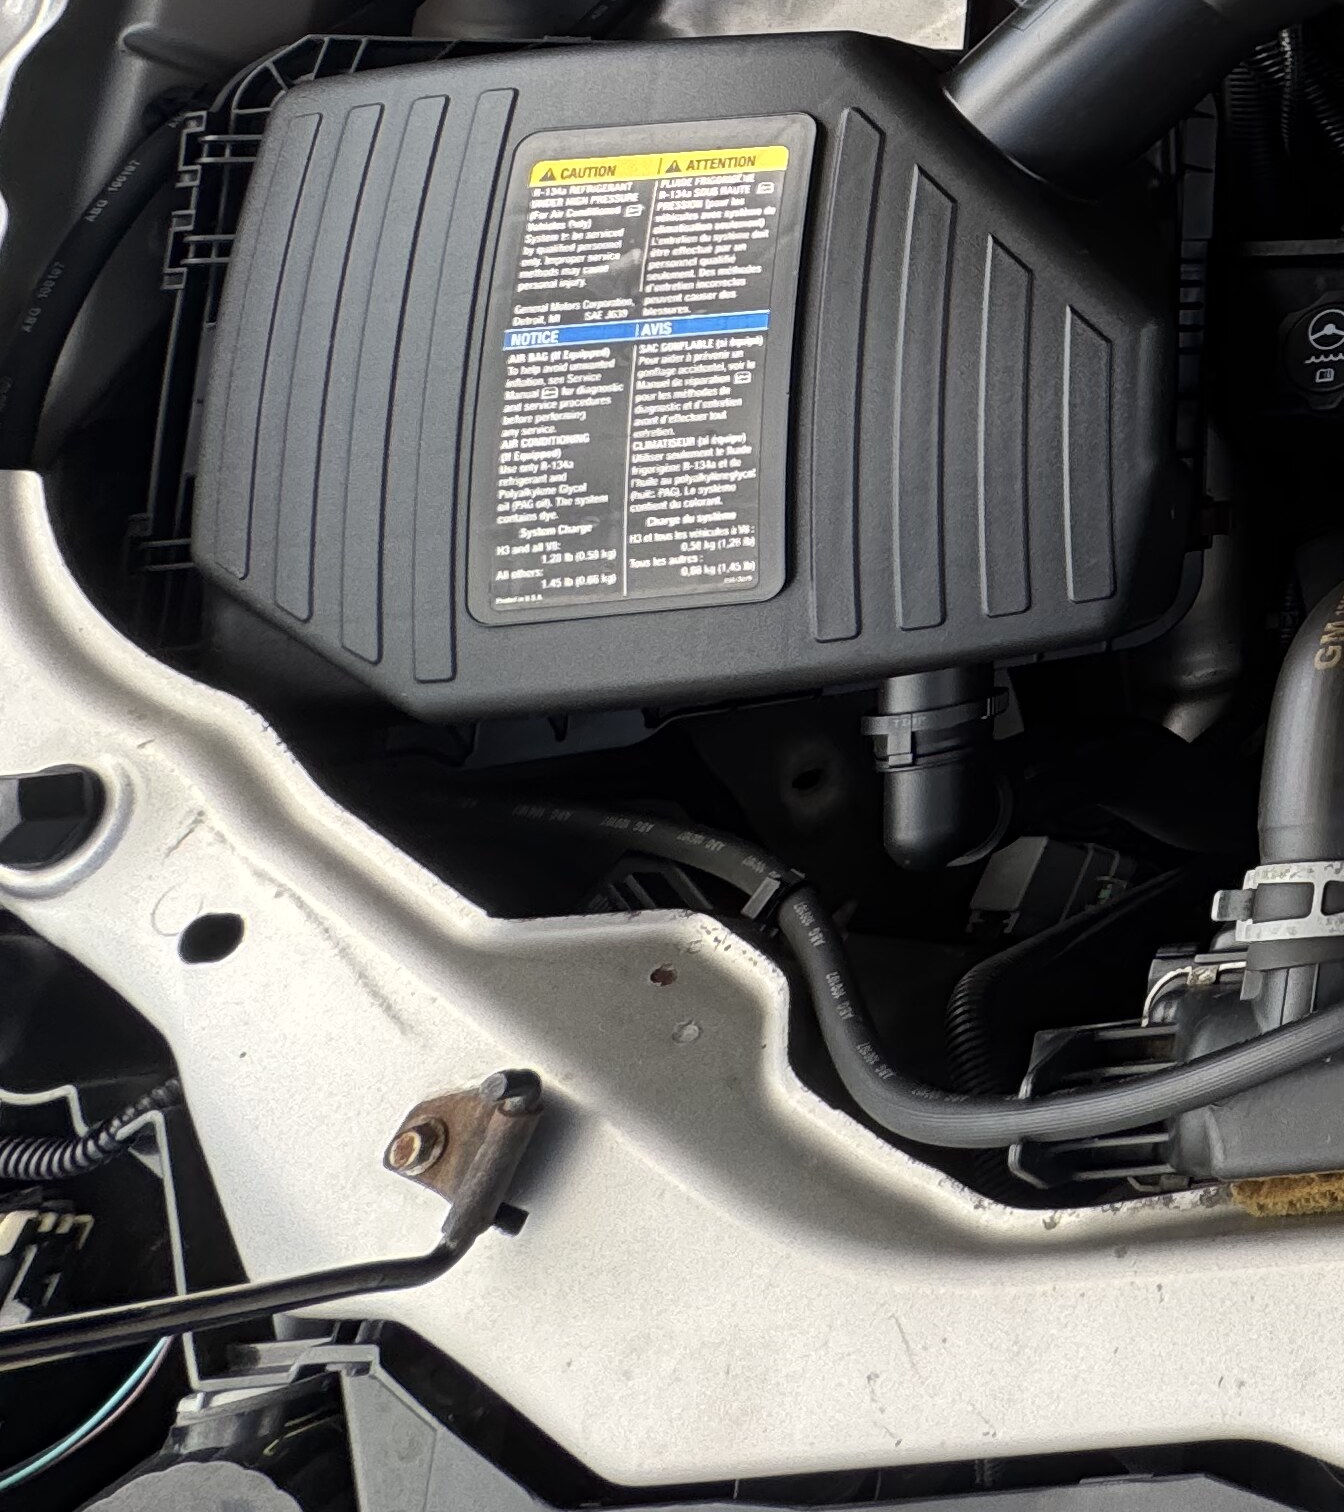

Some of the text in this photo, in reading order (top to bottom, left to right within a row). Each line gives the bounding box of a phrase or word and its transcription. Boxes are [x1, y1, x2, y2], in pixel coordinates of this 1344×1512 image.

[686, 156, 756, 171] ATTENTION
[561, 165, 616, 180] CAUTION
[641, 322, 672, 336] AVIS
[511, 330, 559, 346] NOTICE
